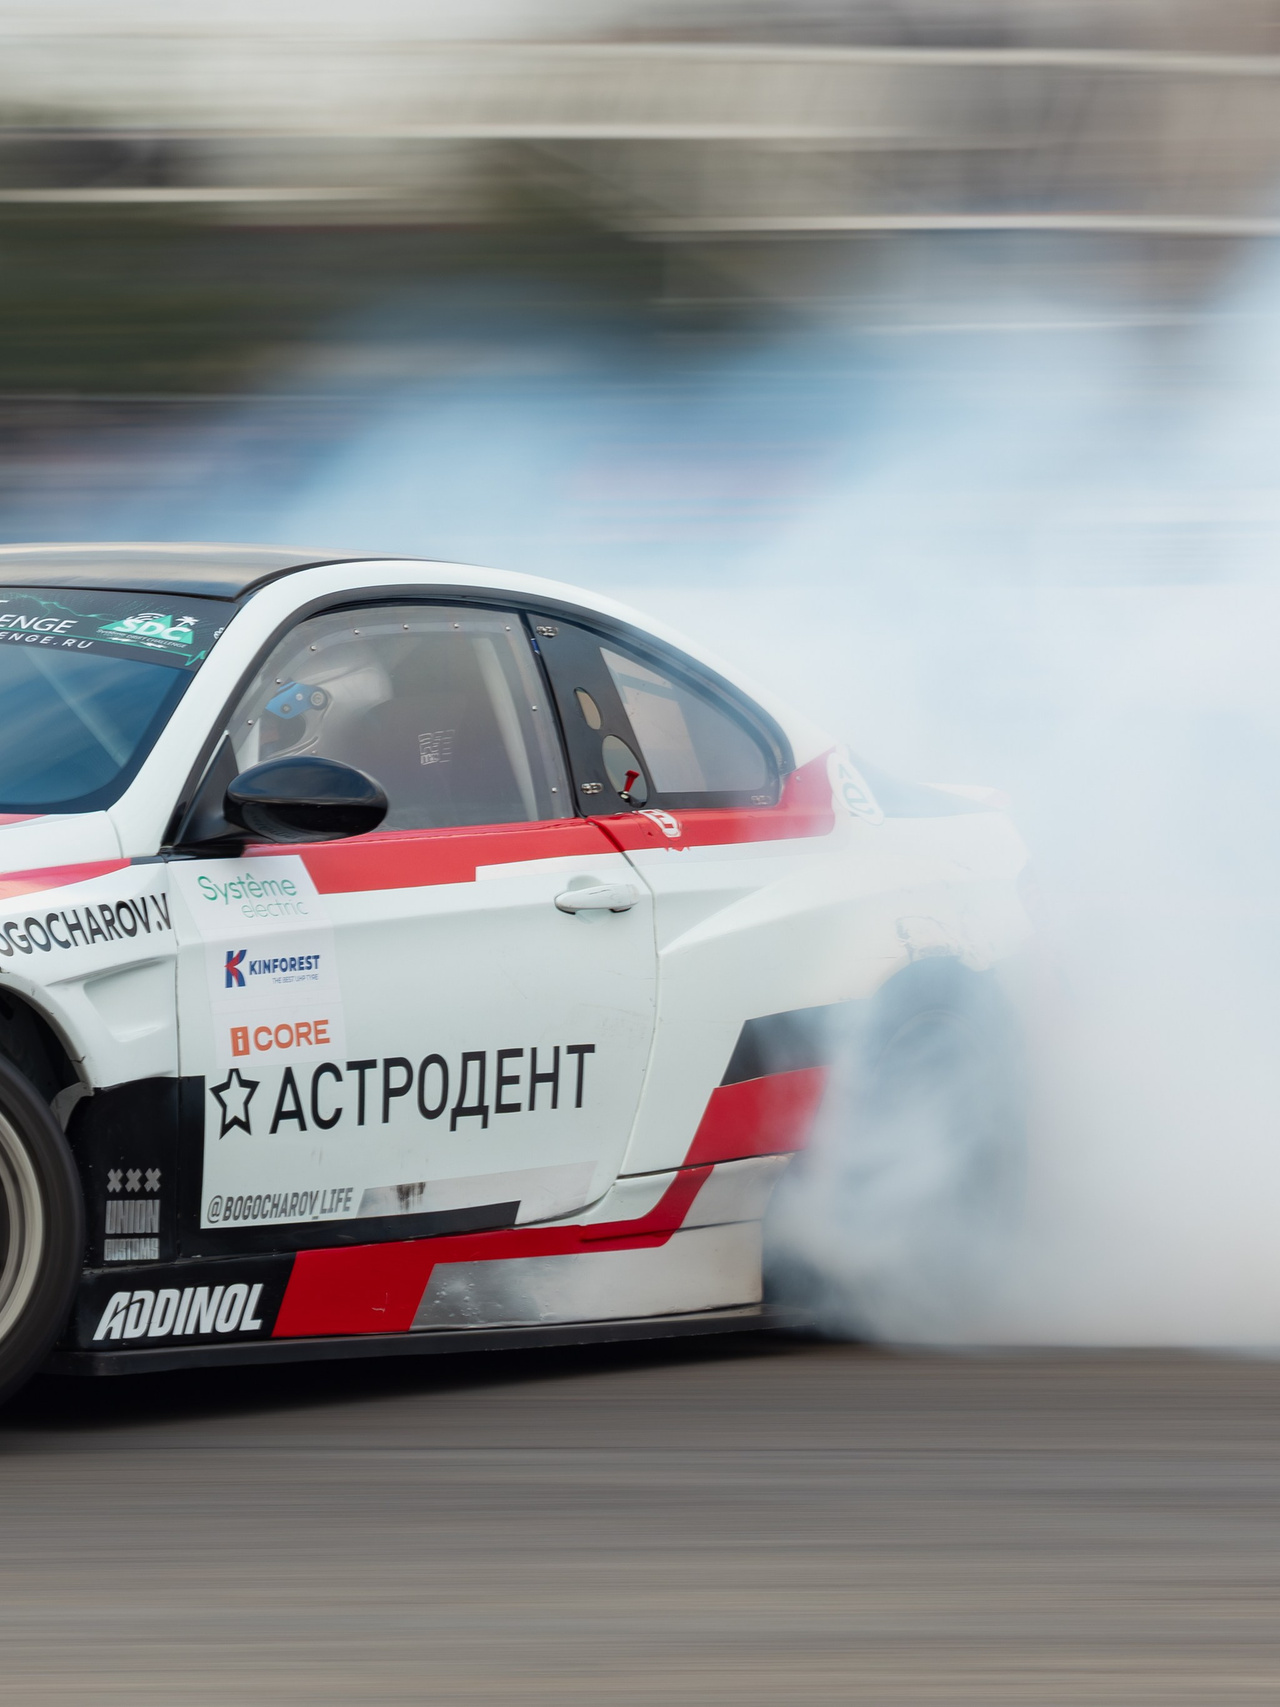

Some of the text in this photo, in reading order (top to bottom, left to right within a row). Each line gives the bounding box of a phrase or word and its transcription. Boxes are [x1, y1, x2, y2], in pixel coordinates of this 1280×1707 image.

[113, 619, 193, 641] SDC
[197, 873, 297, 905] Systême
[241, 900, 309, 918] electric
[249, 955, 320, 976] KINFOREST
[269, 1044, 596, 1132] АСТРОДЕНТ
[104, 1199, 160, 1234] UNION
[207, 1187, 354, 1224] @BOGOCHAROV_LIFE
[92, 1283, 265, 1341] ADDINOL
